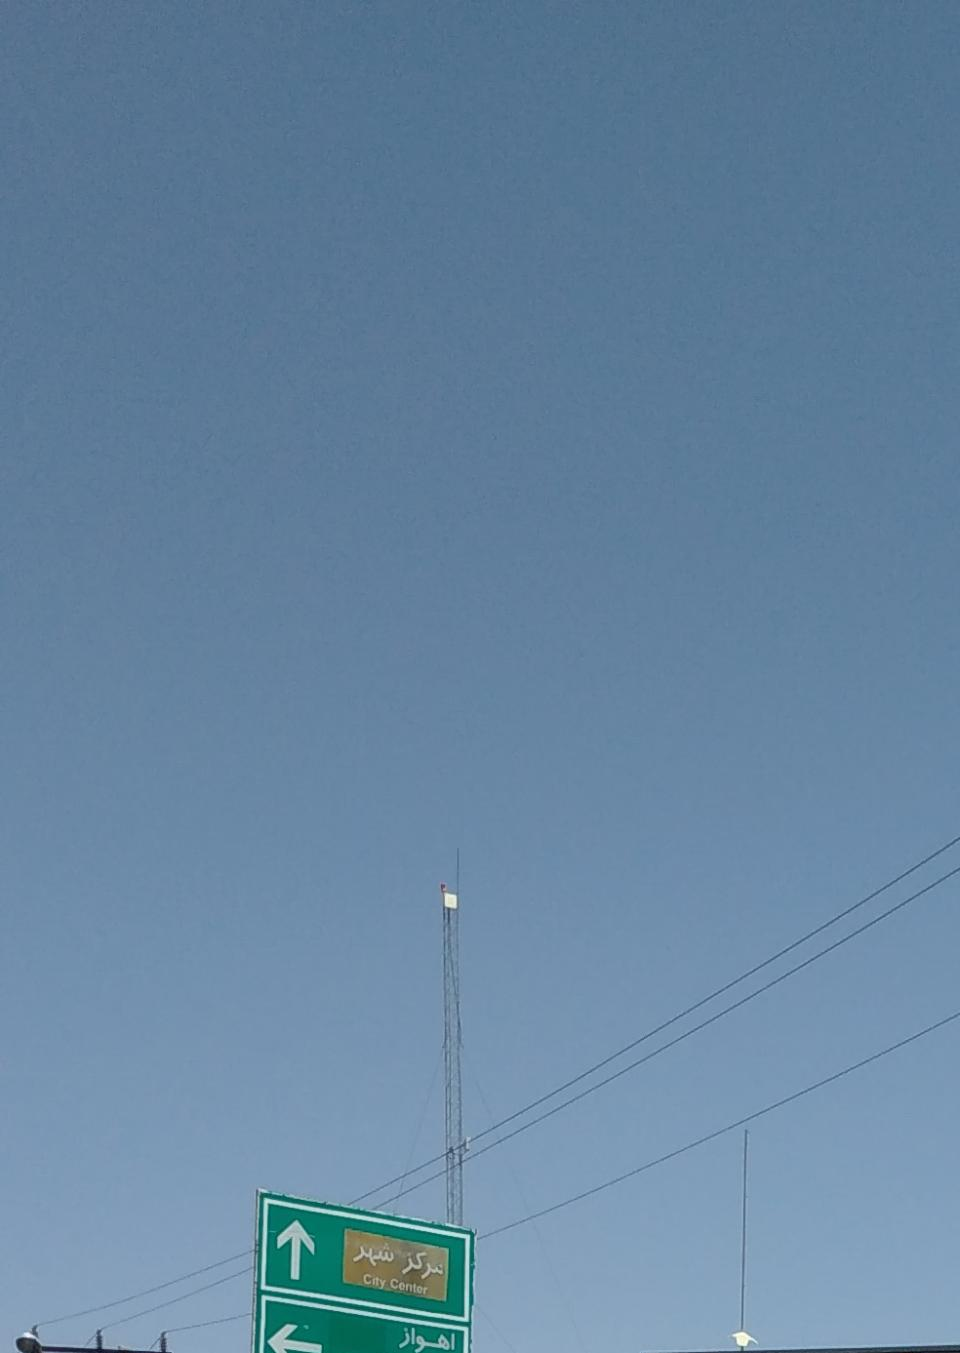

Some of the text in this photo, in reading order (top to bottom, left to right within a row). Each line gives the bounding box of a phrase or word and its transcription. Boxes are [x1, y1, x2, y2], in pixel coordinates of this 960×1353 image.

[352, 1242, 444, 1280] مرکز شهر
[363, 1273, 429, 1295] City Center
